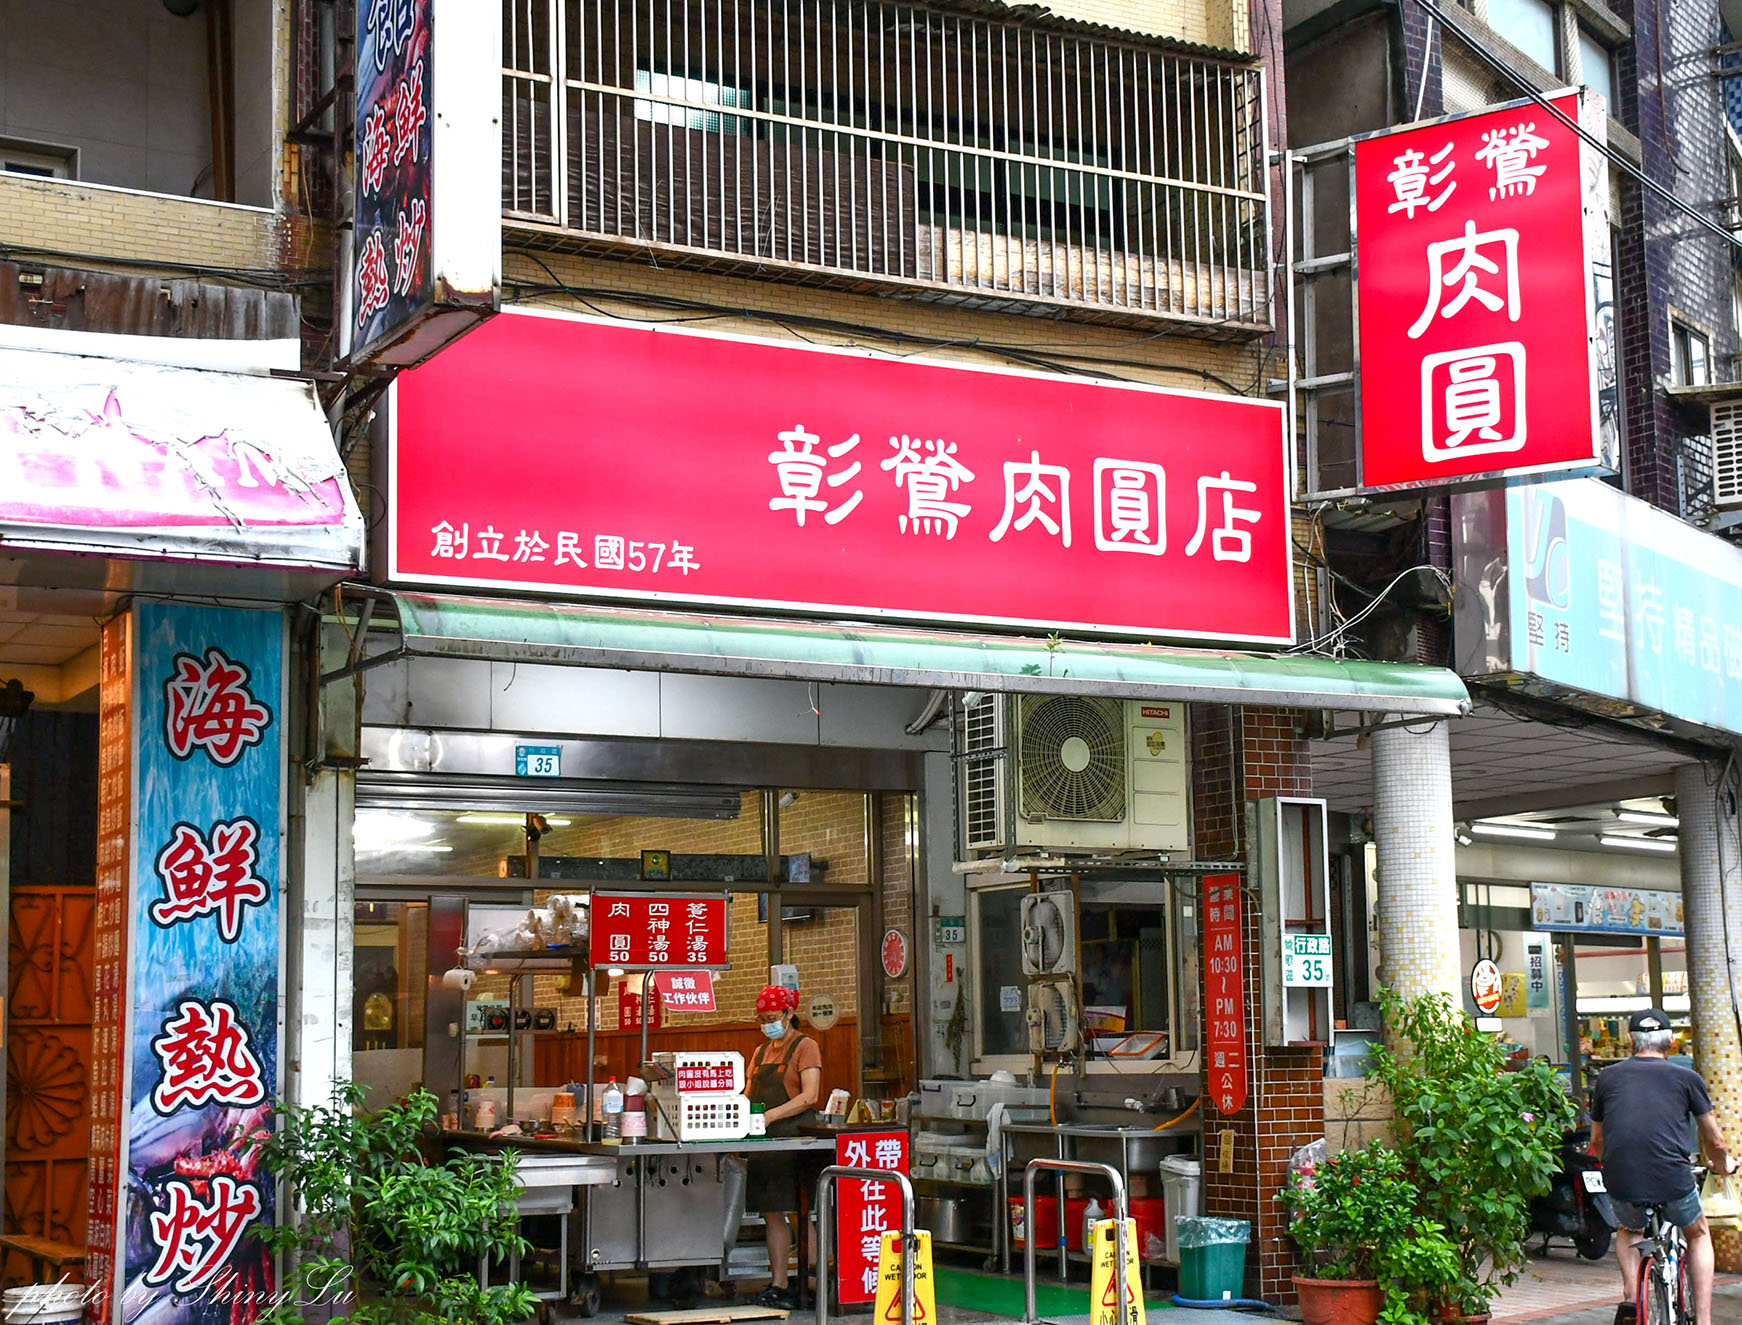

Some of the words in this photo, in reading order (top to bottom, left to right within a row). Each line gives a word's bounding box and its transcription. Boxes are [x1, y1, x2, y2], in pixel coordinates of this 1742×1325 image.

[361, 59, 427, 198] 海鮮
[1387, 122, 1550, 219] 彰鶯
[359, 198, 426, 328] 熱炒
[1407, 219, 1527, 463] 肉圓
[767, 423, 1263, 563] 彰鶯肉圓店
[430, 520, 701, 576] 創立於民國57年
[535, 757, 552, 773] 35
[1209, 905, 1235, 922] 時間
[608, 902, 631, 950] 肉圓
[647, 903, 670, 951] 四神湯
[685, 903, 709, 951] 薏仁湯
[945, 929, 958, 940] 35
[1214, 935, 1233, 951] AM
[1295, 937, 1330, 954] 行政路
[609, 952, 629, 962] 50
[648, 952, 668, 962] 50
[687, 952, 707, 962] 35
[1210, 957, 1237, 974] 10:30
[145, 648, 272, 1296] 海鮮熱炒
[1302, 960, 1323, 981] 35
[1530, 956, 1543, 993] 招募中
[662, 992, 710, 1005] 工作伙伴
[1216, 998, 1234, 1015] PM
[1214, 1021, 1237, 1038] 7:30
[1214, 1051, 1240, 1069] 週二
[1221, 1072, 1234, 1110] 公休
[844, 1139, 903, 1169] 外帶
[1101, 1260, 1113, 1268] WET
[884, 1272, 900, 1281] WET
